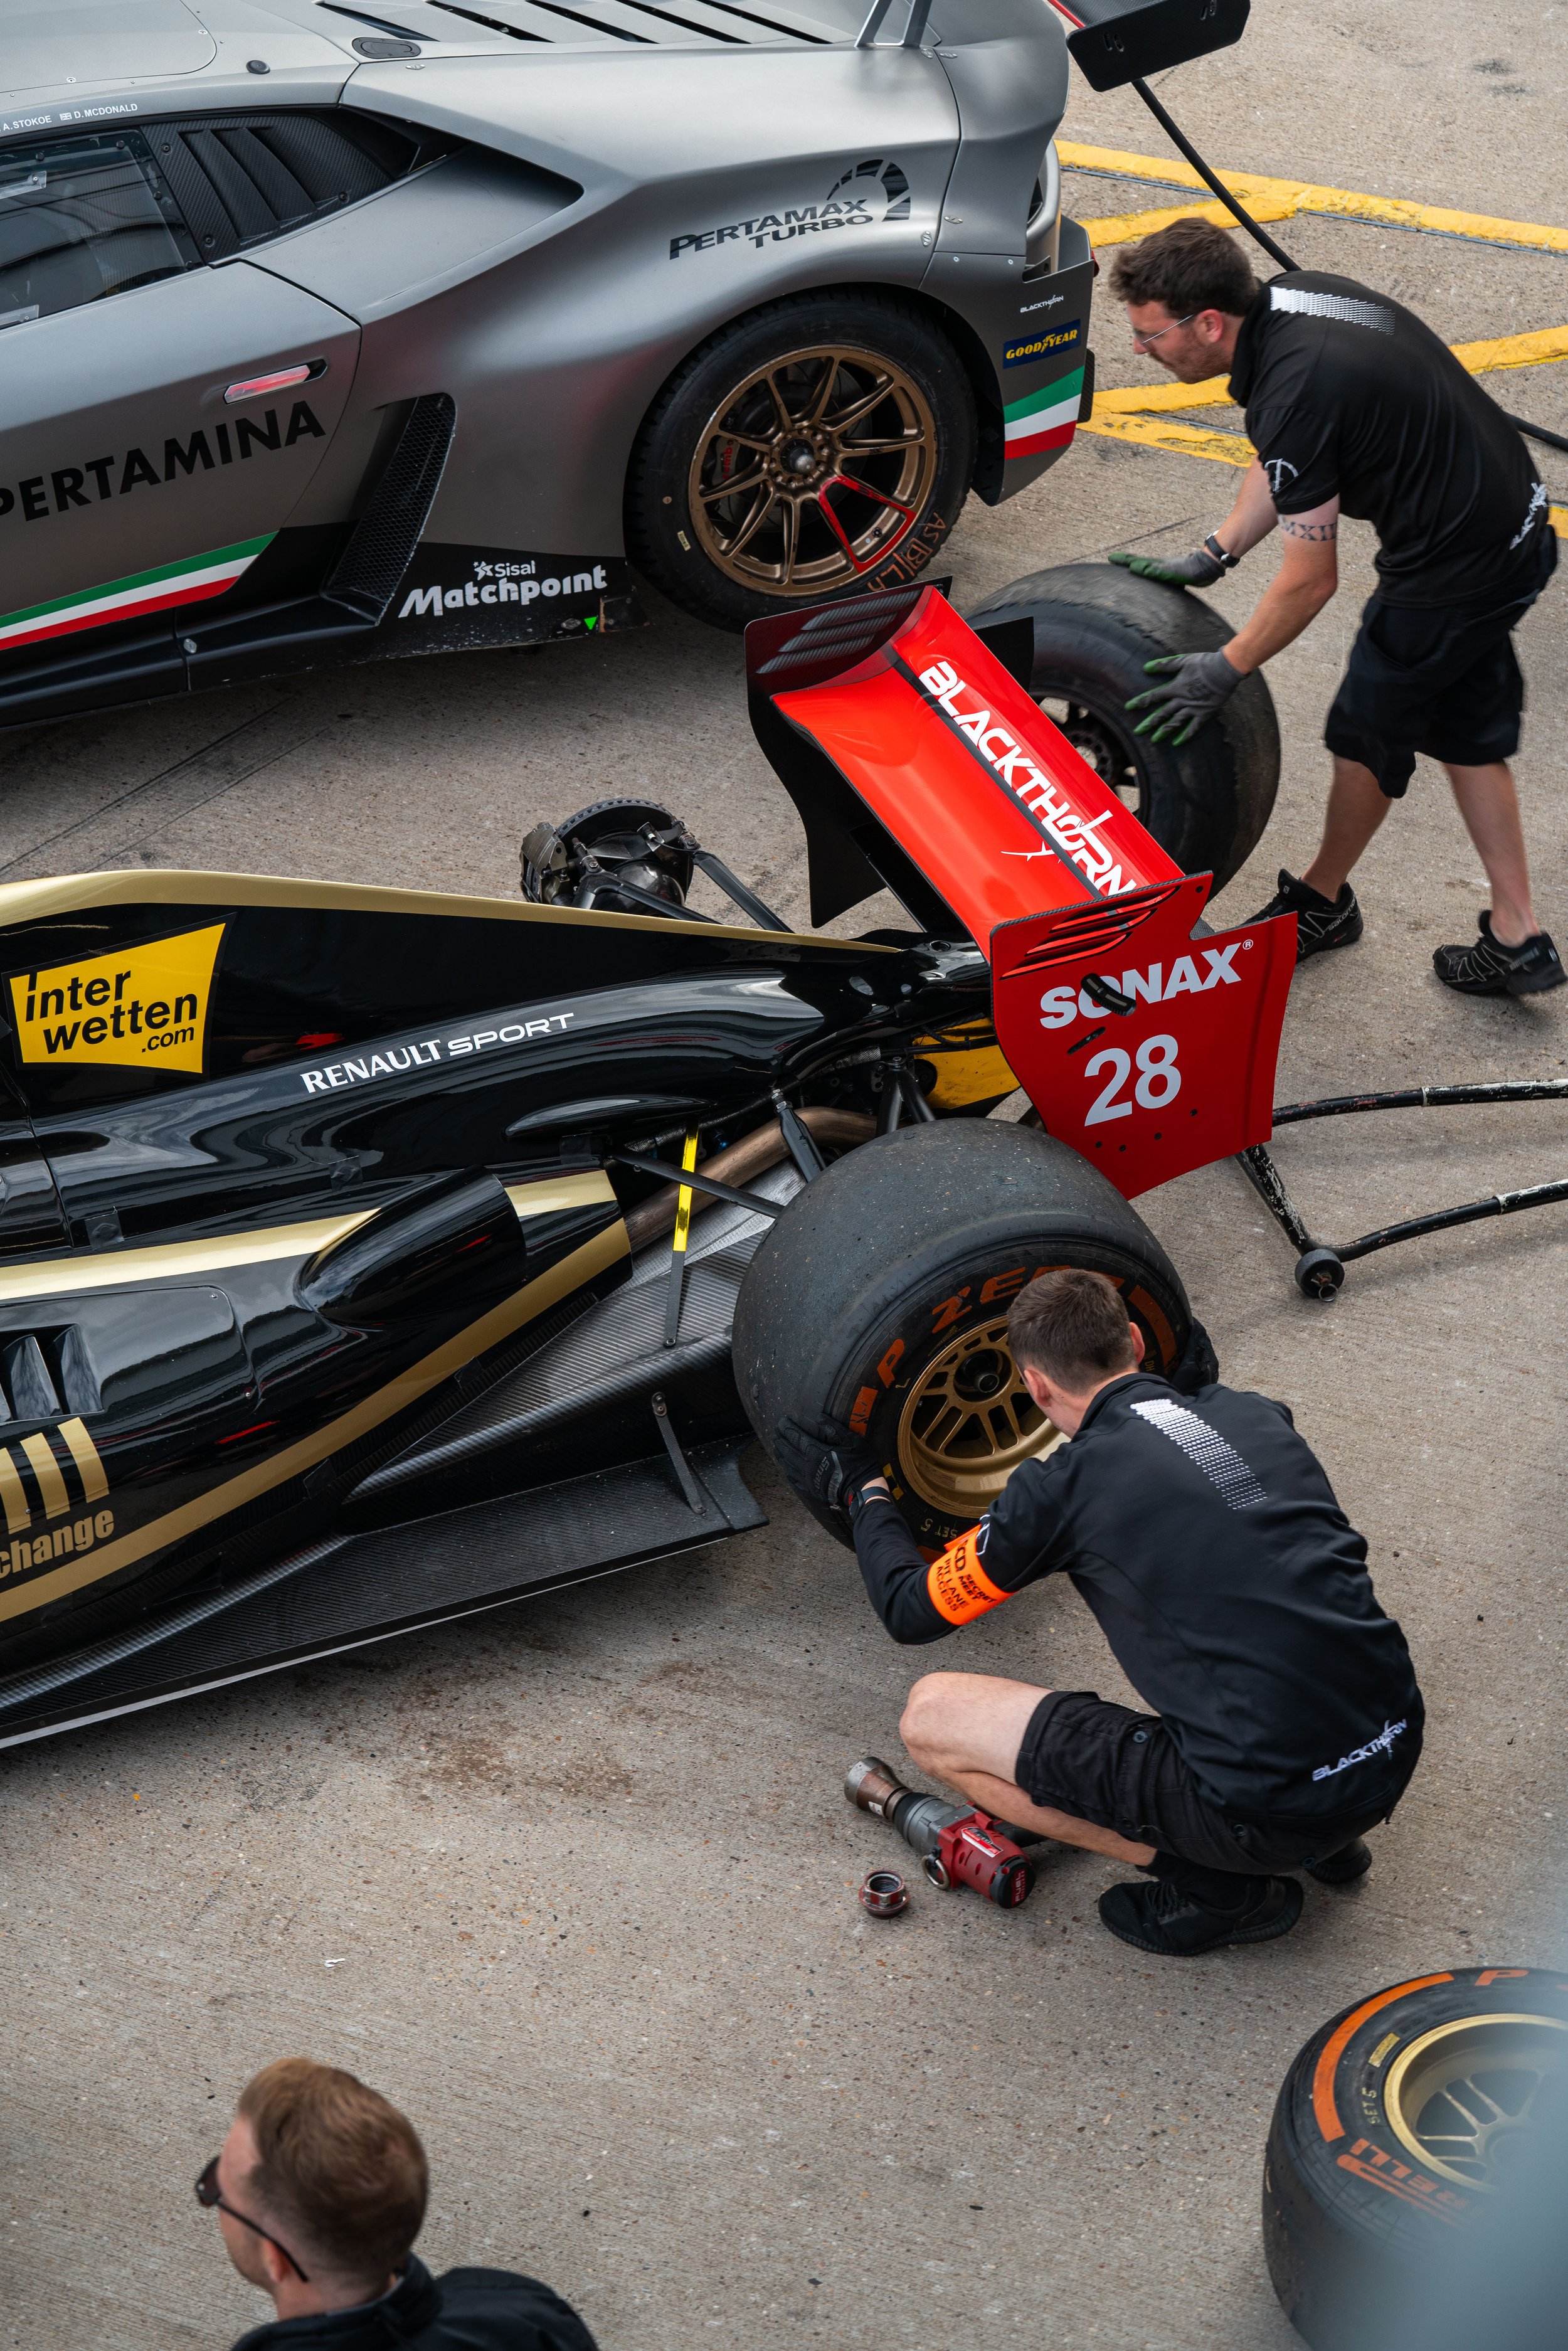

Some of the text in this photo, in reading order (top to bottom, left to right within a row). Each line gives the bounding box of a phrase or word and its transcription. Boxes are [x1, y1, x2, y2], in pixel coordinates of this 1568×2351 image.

[669, 199, 867, 260] PERTAMAX
[748, 215, 873, 249] TURBO
[1020, 294, 1064, 313] BLACKTHORN
[1006, 329, 1078, 359] GOODYEAR
[722, 440, 734, 479] rembo
[398, 565, 608, 618] Matchpoint
[494, 560, 536, 578] Sisal
[919, 661, 1137, 896] BLACKTHORN
[26, 970, 131, 1022] inter
[43, 993, 198, 1054] wetten
[141, 1027, 194, 1053] .com
[300, 1012, 574, 1093] RENAULT SPORT
[1084, 1034, 1182, 1127] 28
[877, 1339, 904, 1389] P
[936, 1566, 960, 1611] ACCESS
[943, 1558, 970, 1609] PIT LANE
[958, 1576, 980, 1600] MEET
[964, 1574, 997, 1603] SECRET
[1475, 1969, 1529, 1986] P
[1337, 2138, 1471, 2227] PRELLI
